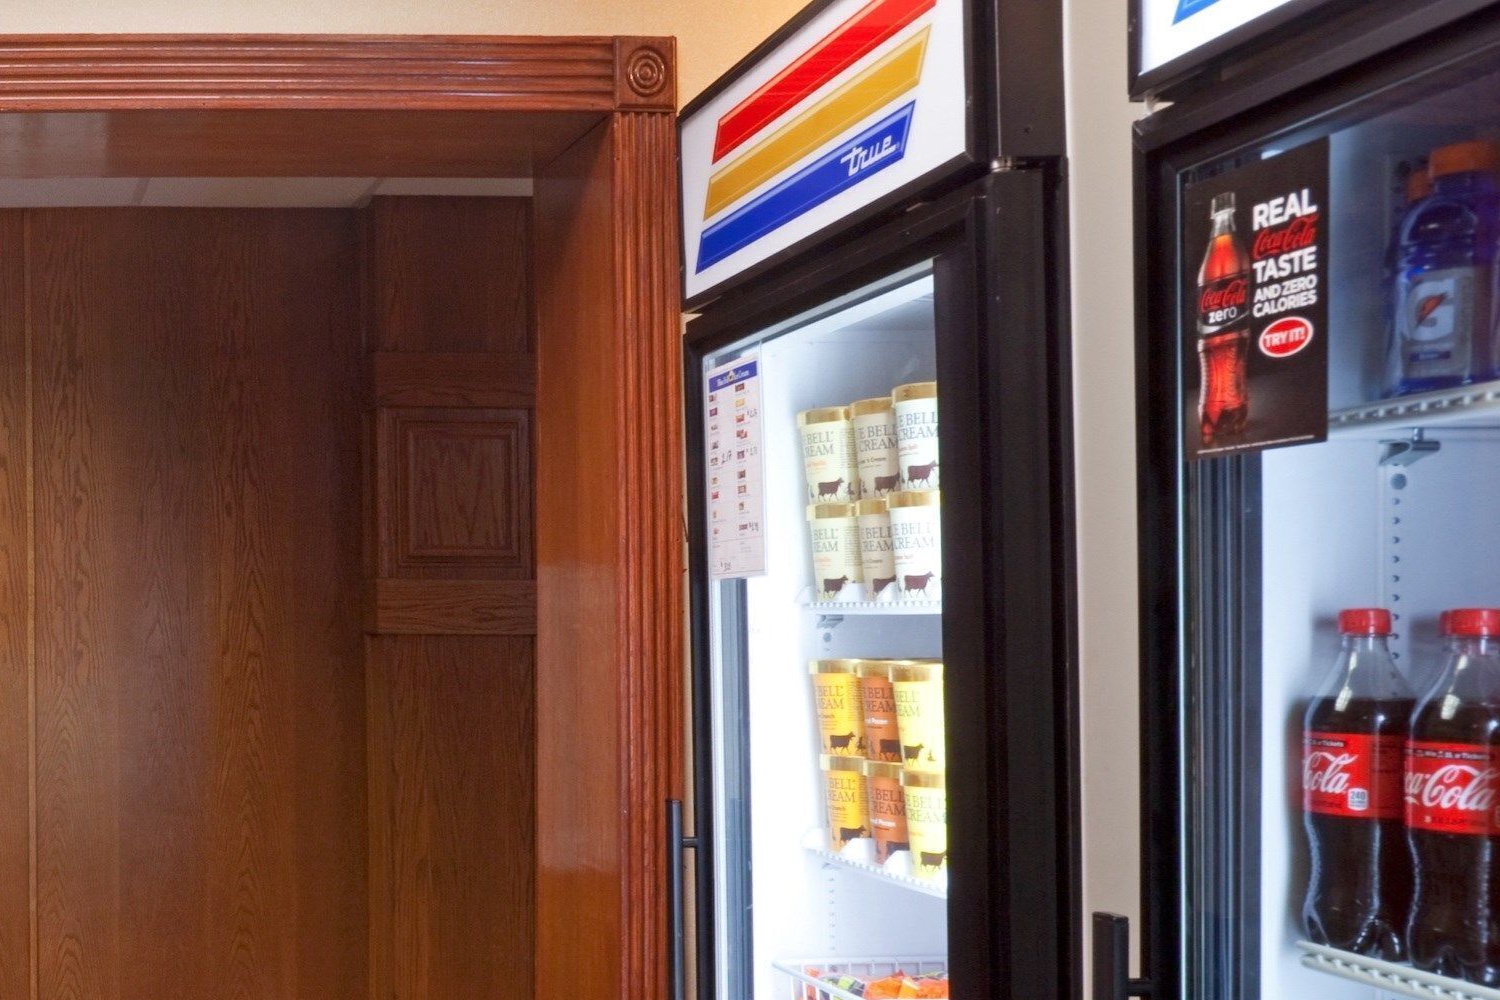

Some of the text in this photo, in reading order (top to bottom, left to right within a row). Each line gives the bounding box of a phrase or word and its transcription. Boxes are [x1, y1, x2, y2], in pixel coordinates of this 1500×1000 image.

[841, 135, 898, 177] true
[1252, 188, 1318, 231] REAL
[1252, 246, 1318, 284] TASTE
[1253, 274, 1318, 303] AND ZERO
[1208, 306, 1238, 324] zero
[1252, 290, 1318, 318] CALORIES
[1265, 326, 1306, 348] TRY IT!
[1350, 788, 1367, 801] 240
